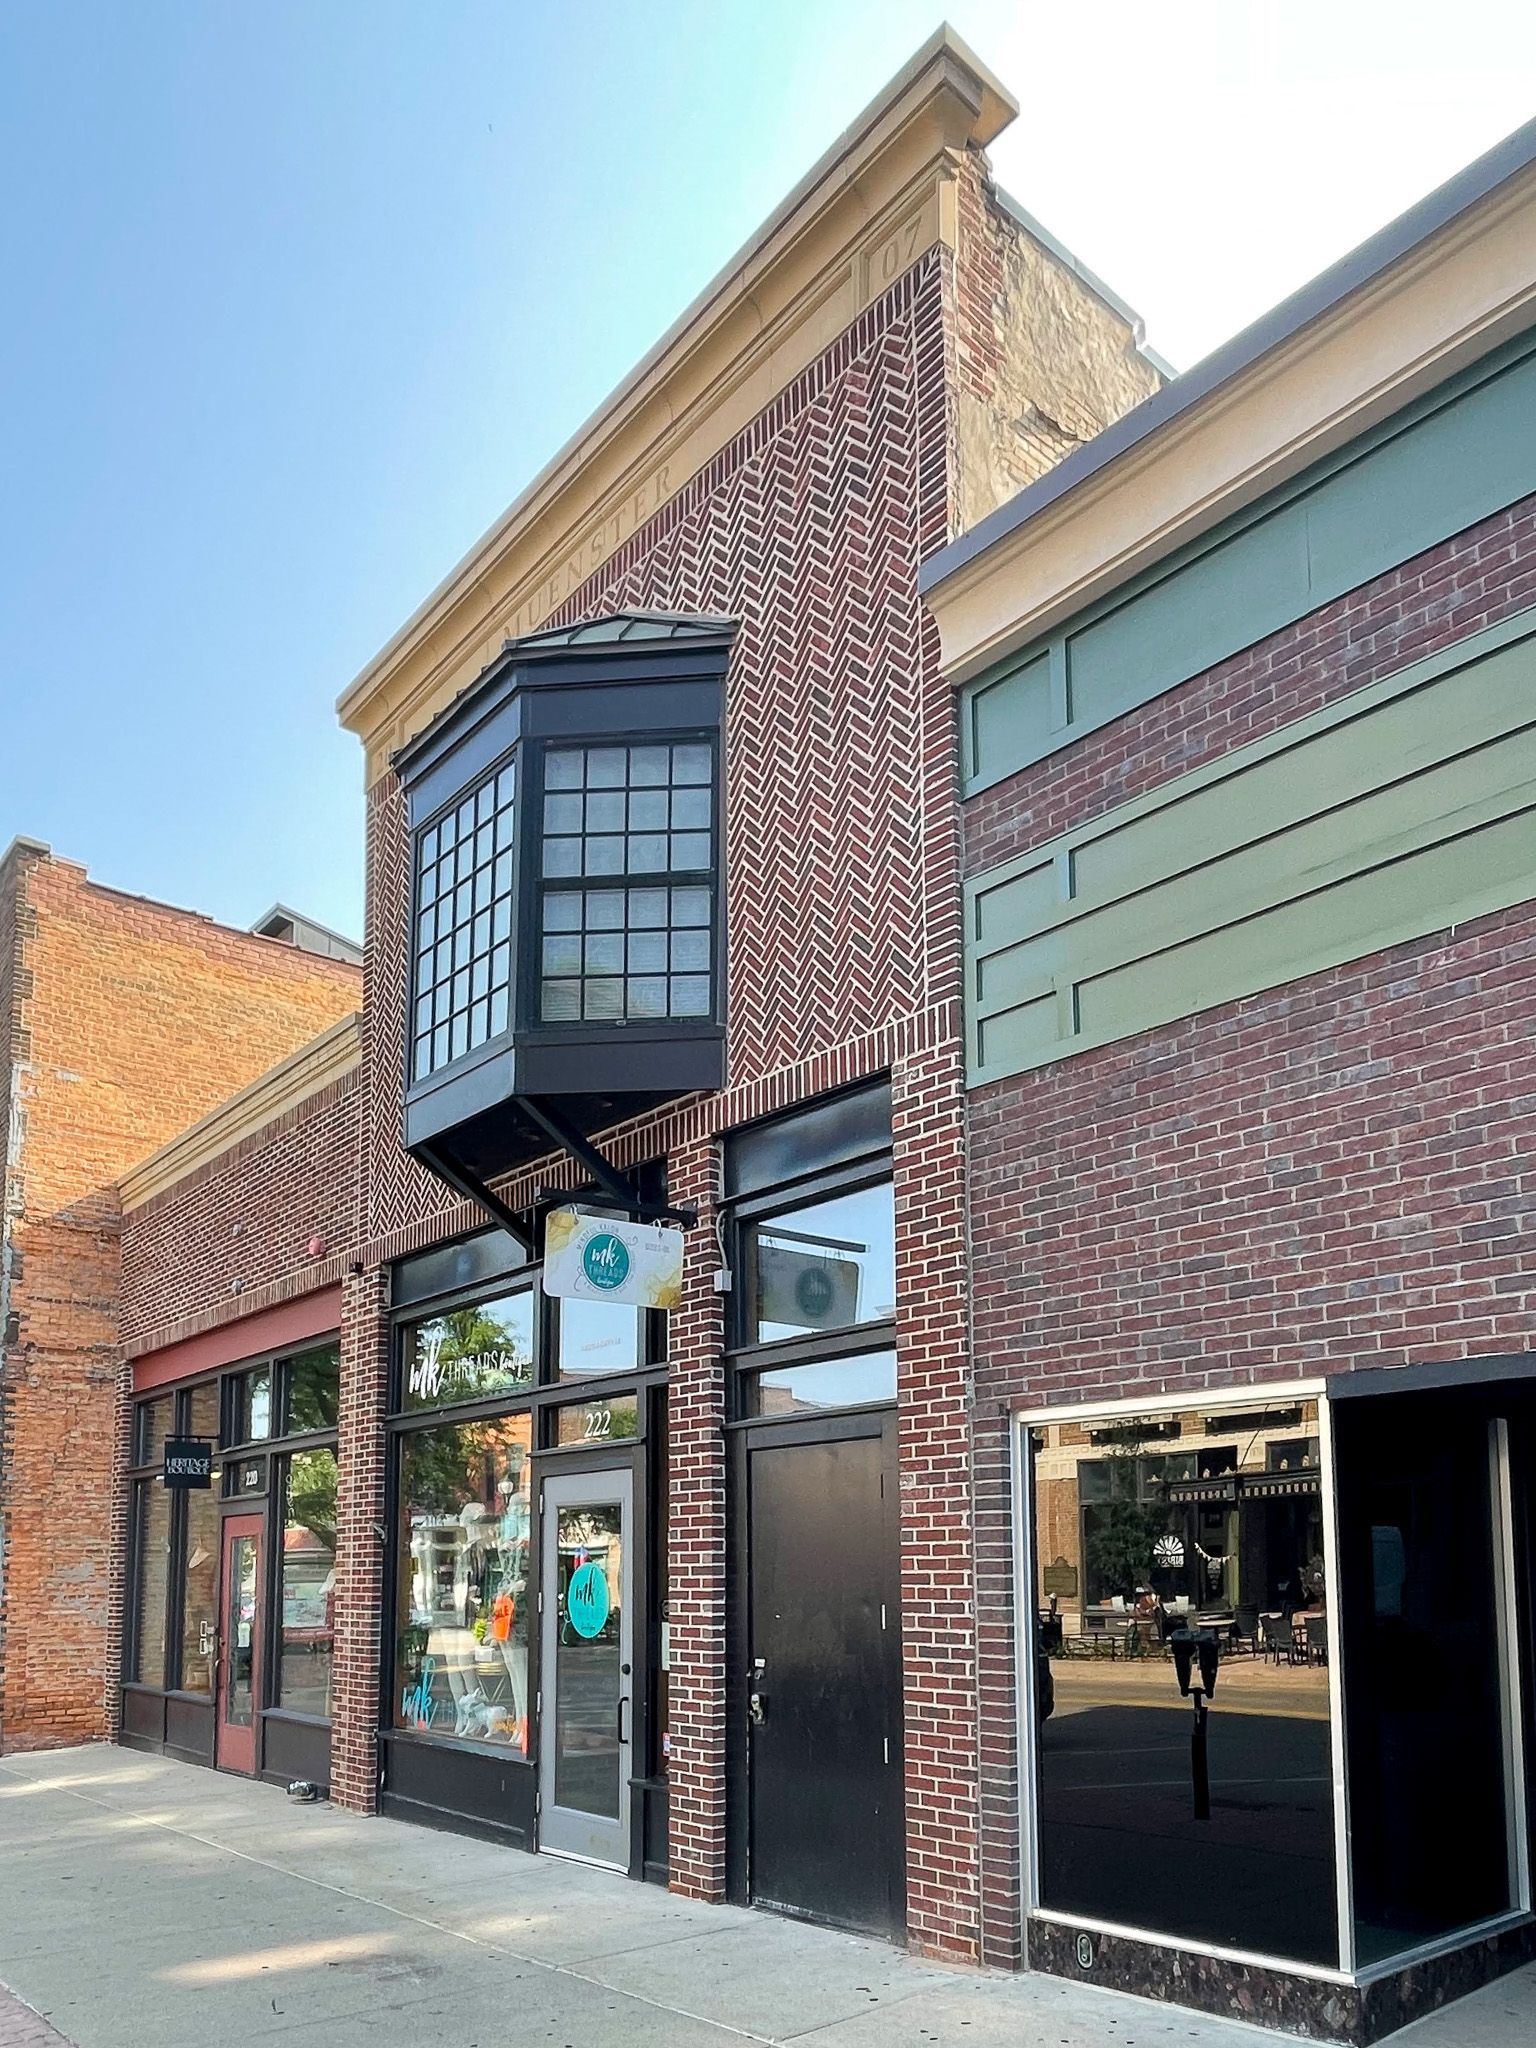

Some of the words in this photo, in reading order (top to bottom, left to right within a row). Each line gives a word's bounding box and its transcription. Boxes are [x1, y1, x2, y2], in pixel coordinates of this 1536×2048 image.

[447, 1350, 499, 1381] THREADS
[584, 1410, 611, 1437] 222
[166, 1457, 210, 1469] HERITAGE
[167, 1466, 209, 1476] BOUTIQUE
